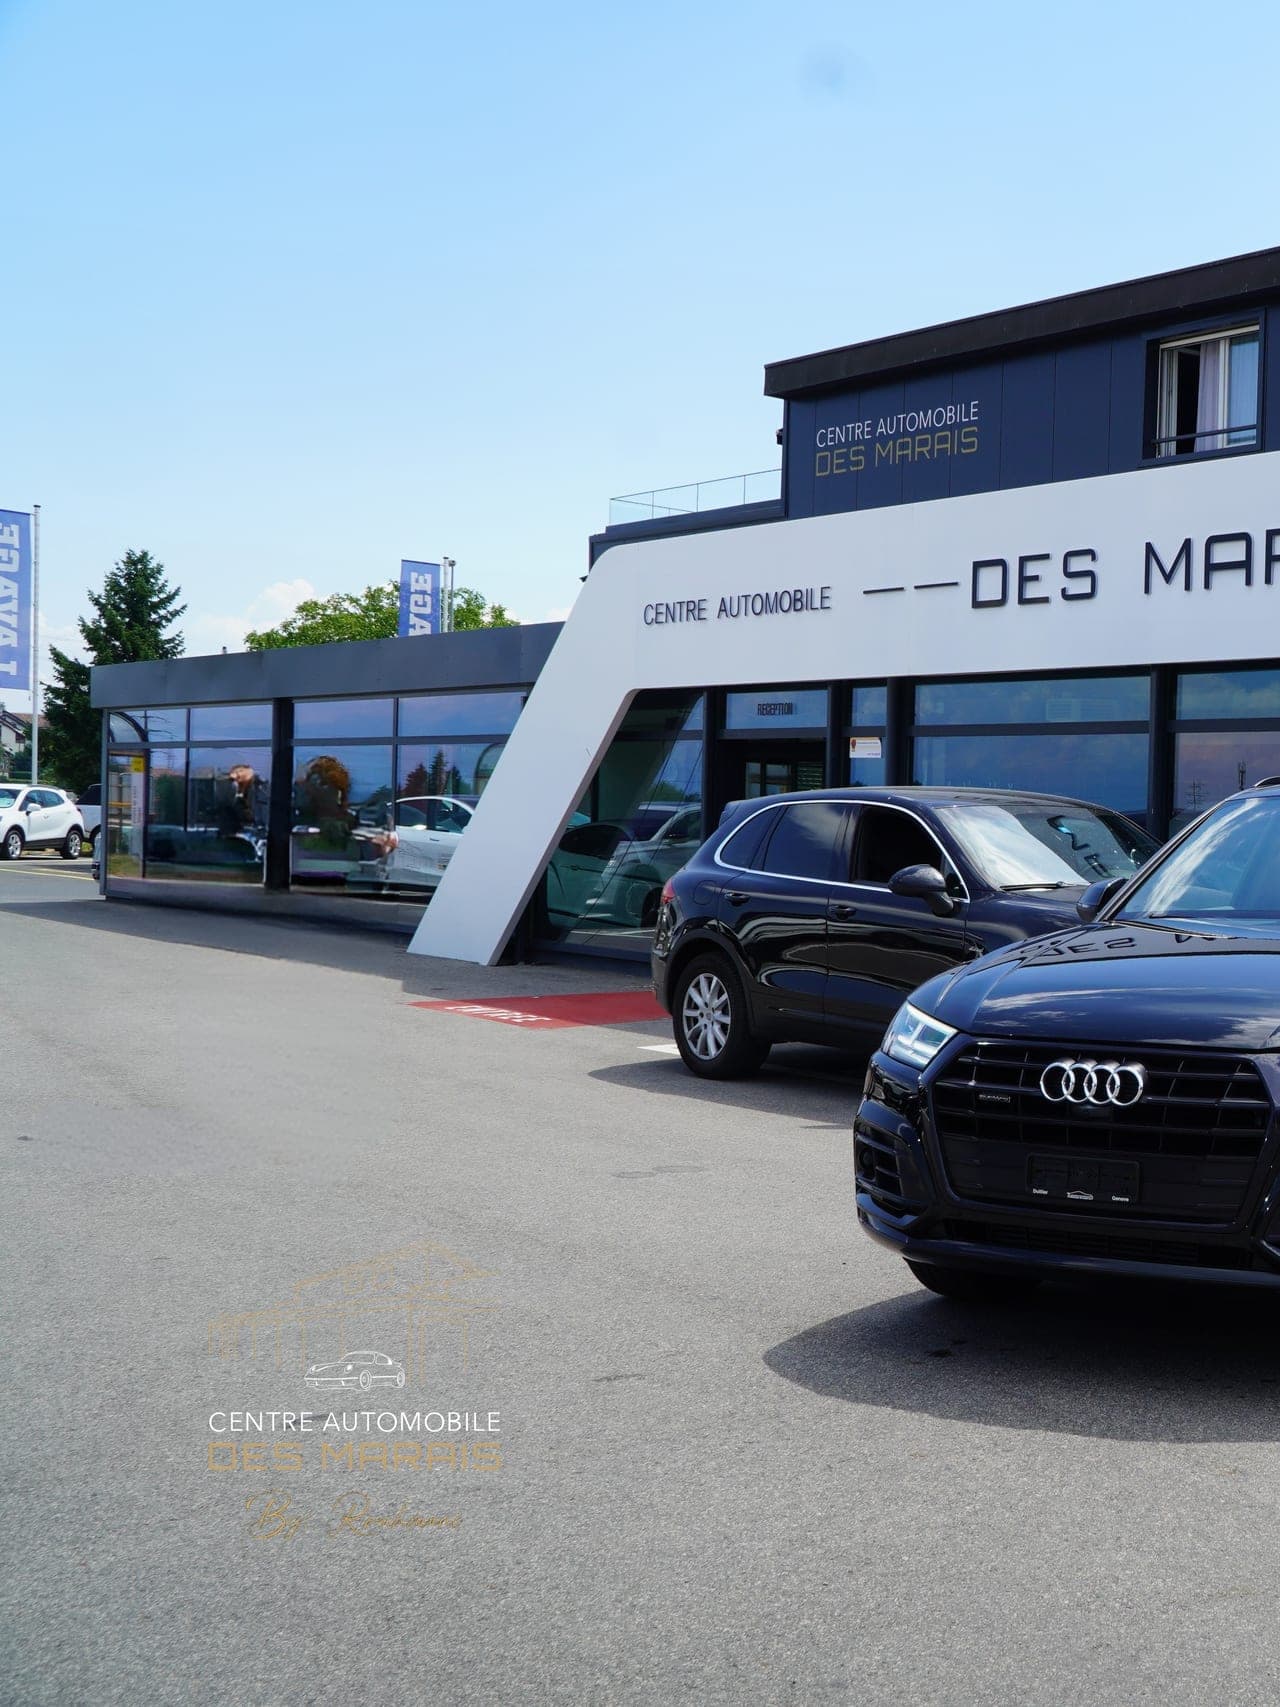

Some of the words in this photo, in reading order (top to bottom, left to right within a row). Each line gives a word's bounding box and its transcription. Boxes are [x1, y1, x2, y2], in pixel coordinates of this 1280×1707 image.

[816, 420, 872, 448] CENTRE
[875, 400, 979, 437] AUTOMOBILE
[815, 445, 865, 477] DES
[875, 426, 978, 467] MARAIS
[643, 599, 707, 626] CENTRE
[717, 586, 831, 619] AUTOMOBILE
[971, 548, 1097, 609] DES
